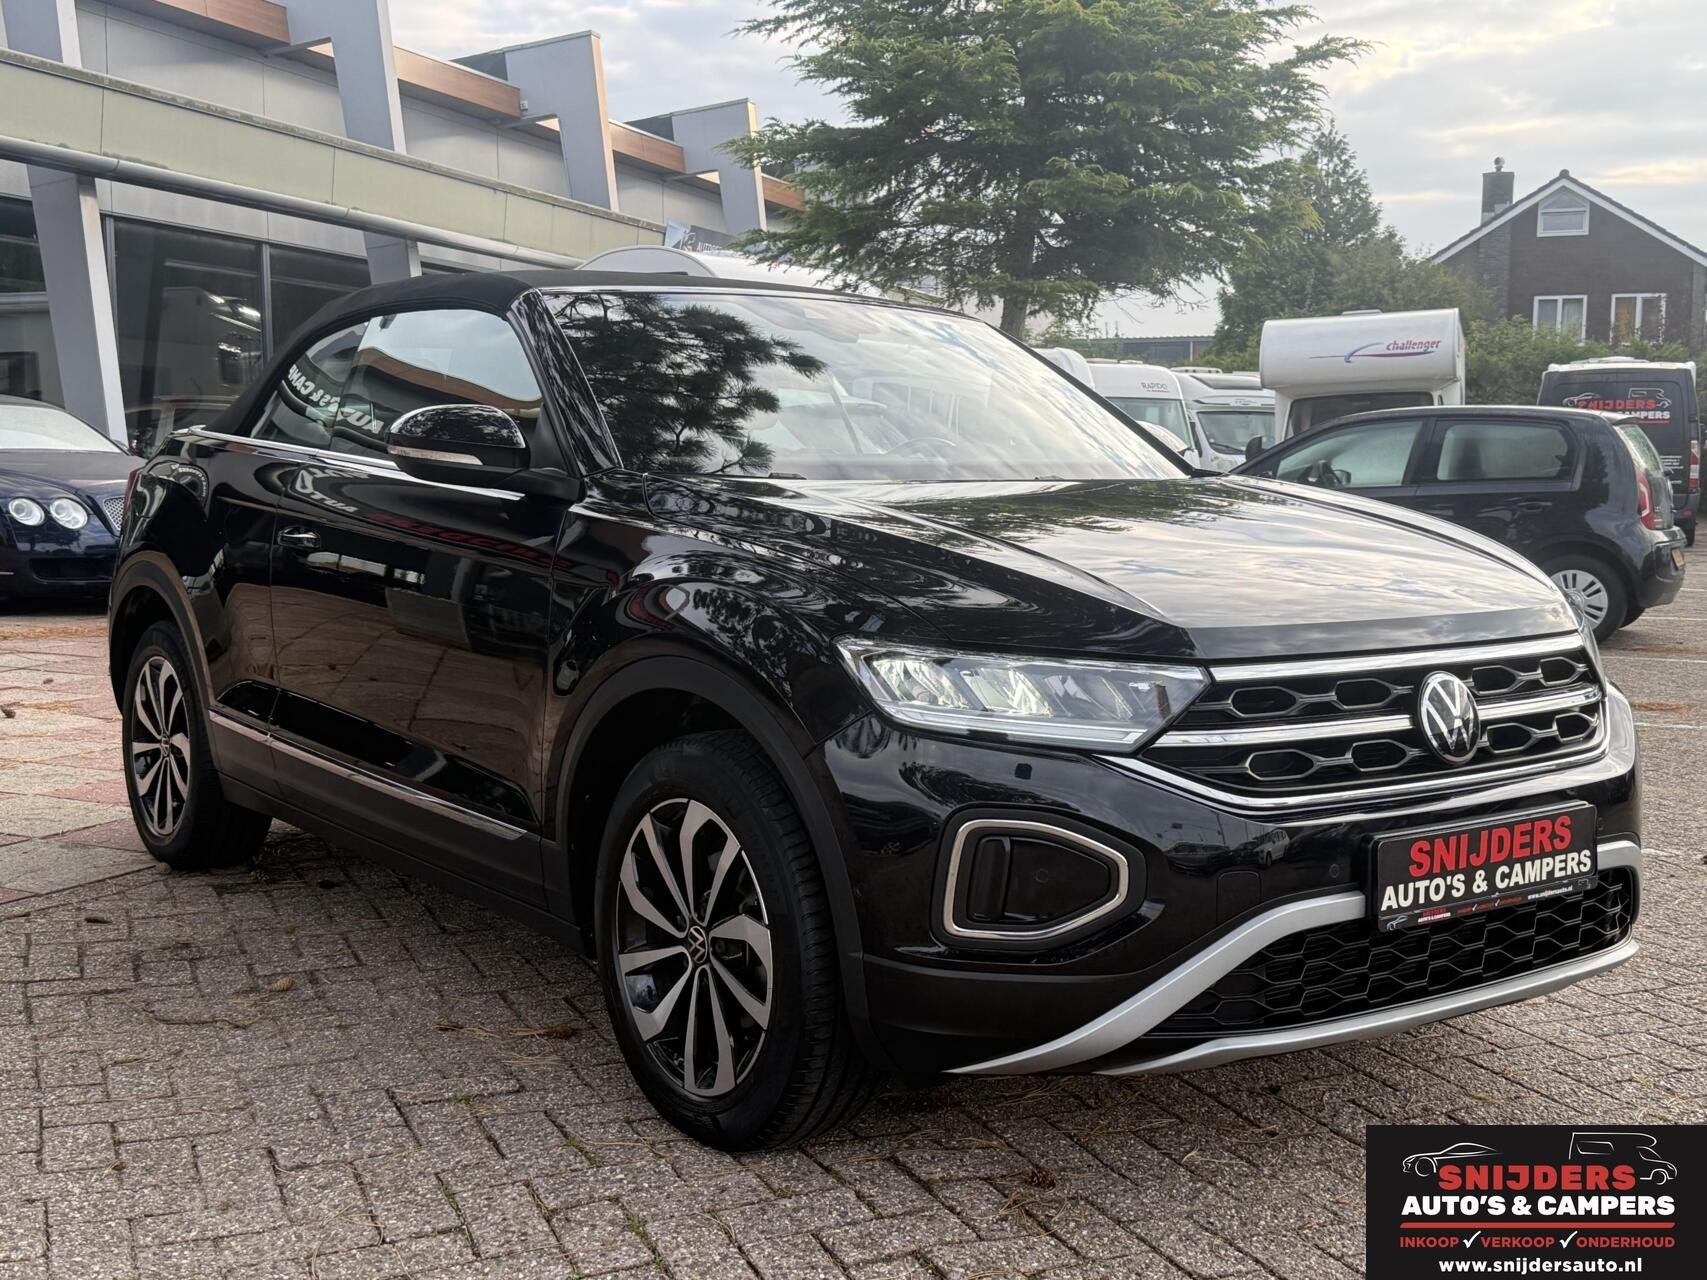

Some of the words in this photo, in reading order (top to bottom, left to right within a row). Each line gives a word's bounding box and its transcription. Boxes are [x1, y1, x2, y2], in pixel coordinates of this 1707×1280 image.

[1386, 340, 1440, 352] challenger
[1141, 382, 1168, 390] RAPIDO
[1577, 399, 1657, 410] SNIJDERS
[1409, 815, 1572, 878] SNIJDERS
[1381, 873, 1465, 912] AUTO'S
[1472, 870, 1488, 894] &
[1495, 849, 1591, 889] CAMPERS
